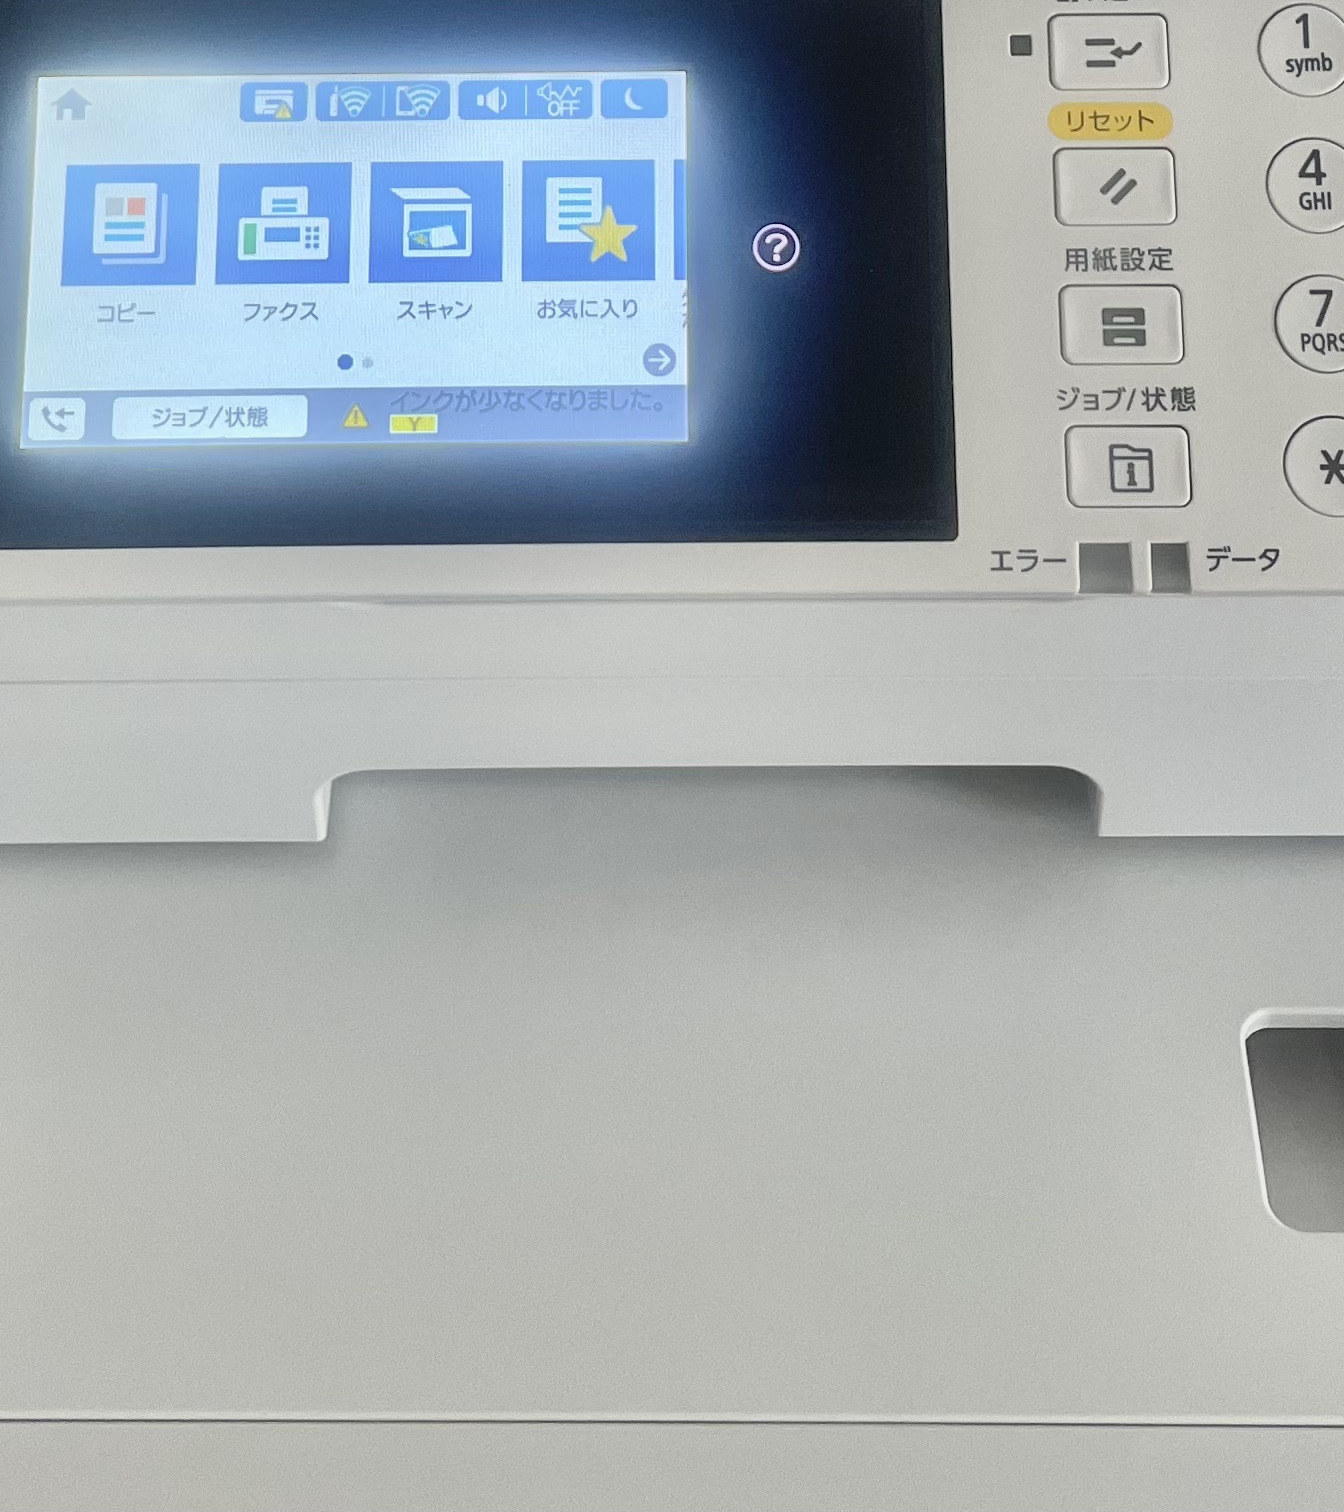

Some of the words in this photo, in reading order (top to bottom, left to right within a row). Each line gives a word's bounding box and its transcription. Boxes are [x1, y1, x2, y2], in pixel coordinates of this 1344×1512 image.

[1295, 12, 1311, 49] 1
[1285, 52, 1333, 77] symb
[548, 100, 580, 117] OFF
[1066, 108, 1154, 132] リセット
[1298, 148, 1326, 186] 4
[1298, 191, 1332, 211] GHI
[1064, 247, 1174, 272] 用紙設定
[96, 303, 156, 323] コピー
[244, 301, 319, 322] ファクス
[396, 300, 473, 321] スキャン
[537, 298, 639, 320] お気に入り
[1308, 289, 1333, 327] 7
[389, 388, 664, 413] インクが少なくなりました。
[1056, 386, 1197, 412] ジョブ/状態
[152, 406, 269, 429] ジョブ/状態
[408, 416, 421, 431] Y
[990, 549, 1067, 573] エラー
[1206, 545, 1281, 572] データ
